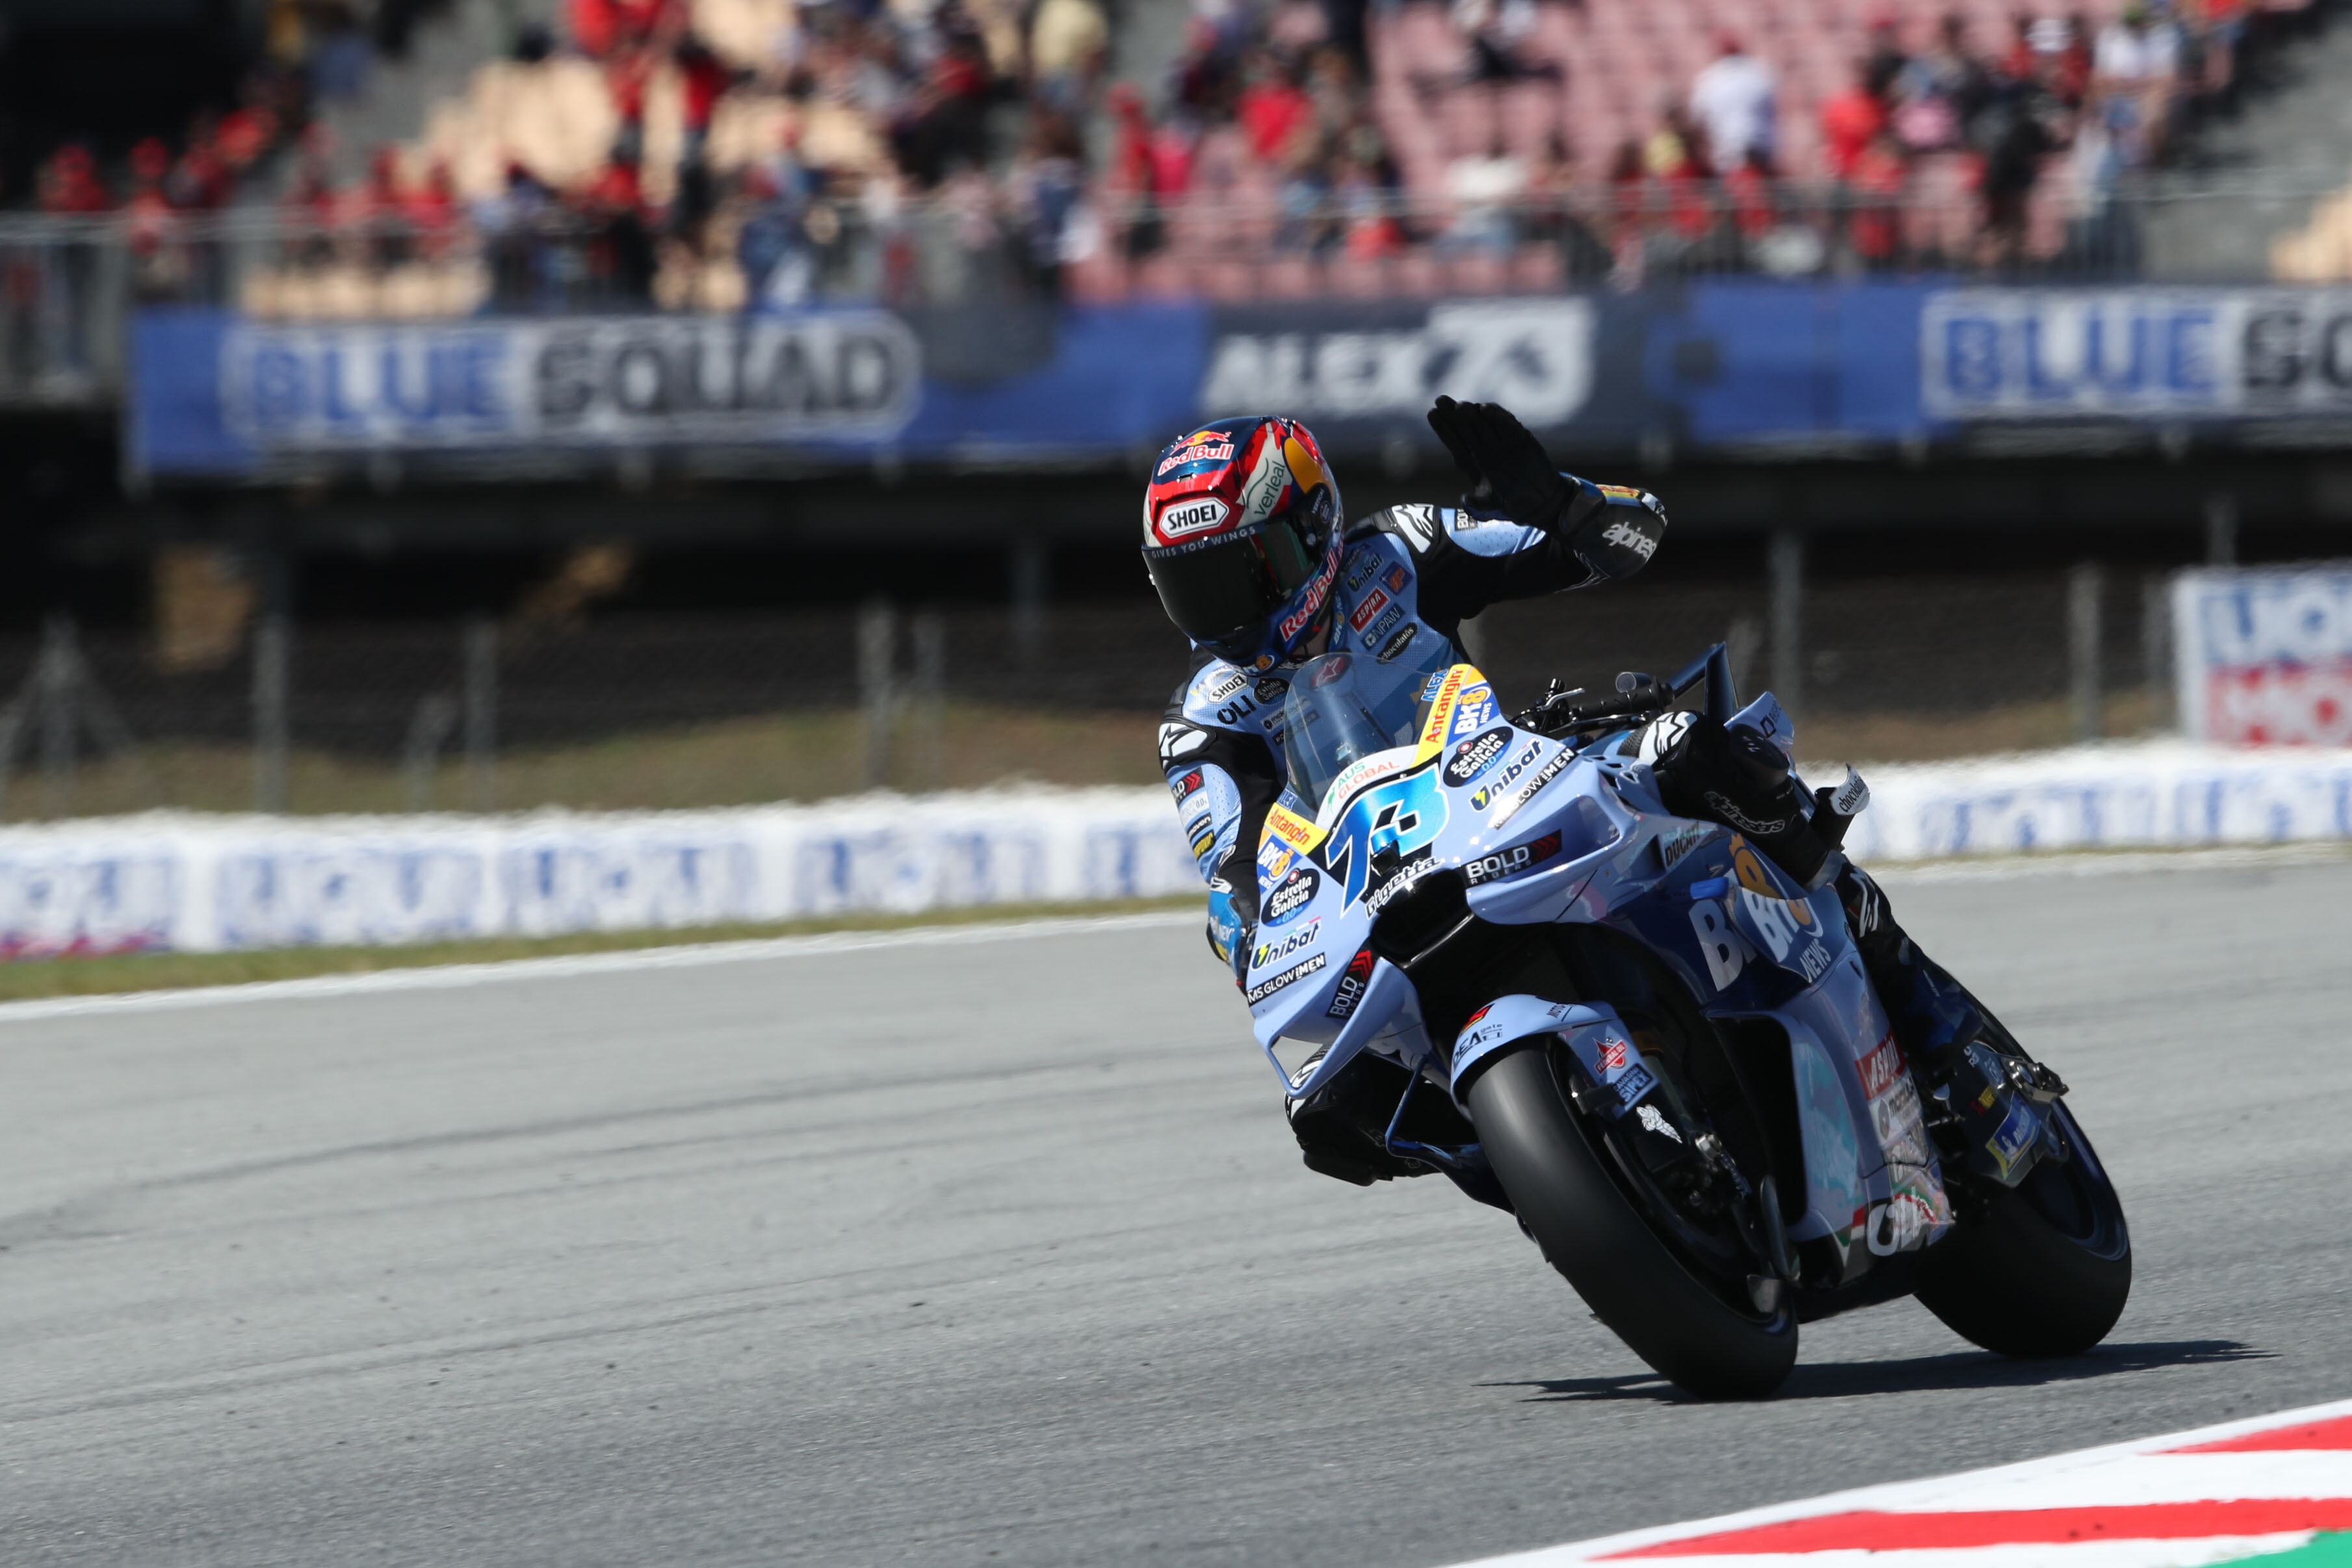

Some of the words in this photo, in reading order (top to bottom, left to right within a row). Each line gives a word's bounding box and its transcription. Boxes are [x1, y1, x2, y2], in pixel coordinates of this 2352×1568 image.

[1158, 450, 1192, 477] Red
[1192, 443, 1235, 461] Bull
[1168, 504, 1217, 530] SHOEI
[1151, 543, 1177, 559] GIVES
[1181, 539, 1205, 553] YOU
[1212, 527, 1257, 546] WINGS
[1279, 593, 1320, 642] Red
[1312, 549, 1339, 609] Bull
[1357, 592, 1381, 624] ASPIRA
[1372, 607, 1401, 638] NPAW
[1212, 675, 1244, 700] SHOEI
[1421, 669, 1450, 702] ALEX
[1425, 669, 1463, 743] Antangin
[1454, 688, 1489, 735] BK8
[1480, 702, 1493, 724] NEWS
[1450, 733, 1498, 775] Estrella
[1460, 740, 1504, 779] Galicia
[1337, 761, 1366, 789] AUS
[1338, 761, 1401, 801] GLOBAL
[1470, 737, 1544, 811] Unibat
[1277, 789, 1298, 811] ALEX
[1703, 790, 1786, 834] alpinestars
[1269, 809, 1311, 846] Antangin
[1325, 763, 1450, 921] 73
[1257, 843, 1294, 880] BK8
[1466, 846, 1530, 879] BOLD
[1470, 859, 1532, 885] RIDERS
[1258, 875, 1274, 890] NEWS
[1272, 876, 1313, 906] Estrella
[1271, 889, 1309, 917] Galicia
[1251, 922, 1322, 971] Unibat
[1799, 937, 1831, 984] NEWS
[1247, 986, 1264, 1004] MS
[1263, 969, 1295, 994] GLOW
[1329, 976, 1358, 1017] BOLD
